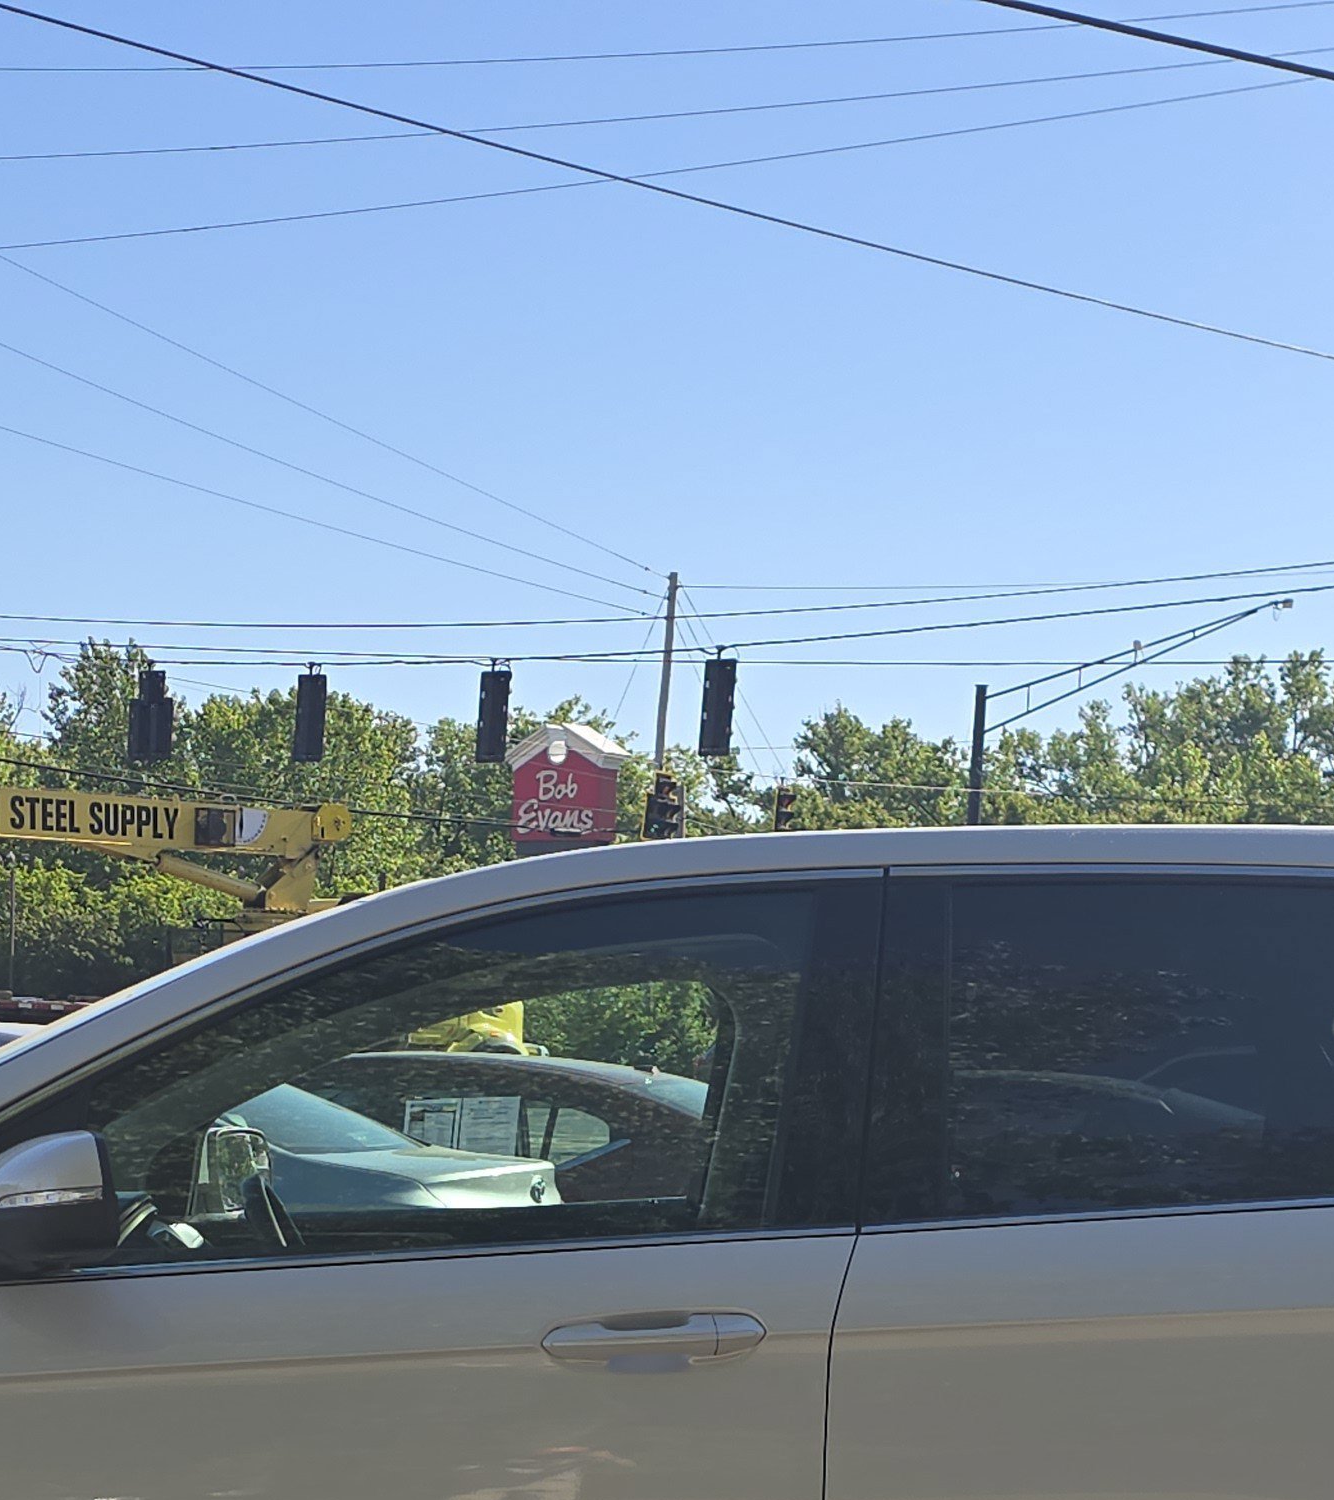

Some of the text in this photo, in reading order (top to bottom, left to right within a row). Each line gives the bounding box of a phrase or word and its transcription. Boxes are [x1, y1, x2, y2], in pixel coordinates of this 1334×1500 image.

[536, 770, 578, 800] Bob
[9, 795, 80, 833] STEEL
[89, 801, 180, 840] SUPPLY
[516, 799, 593, 834] Evans
